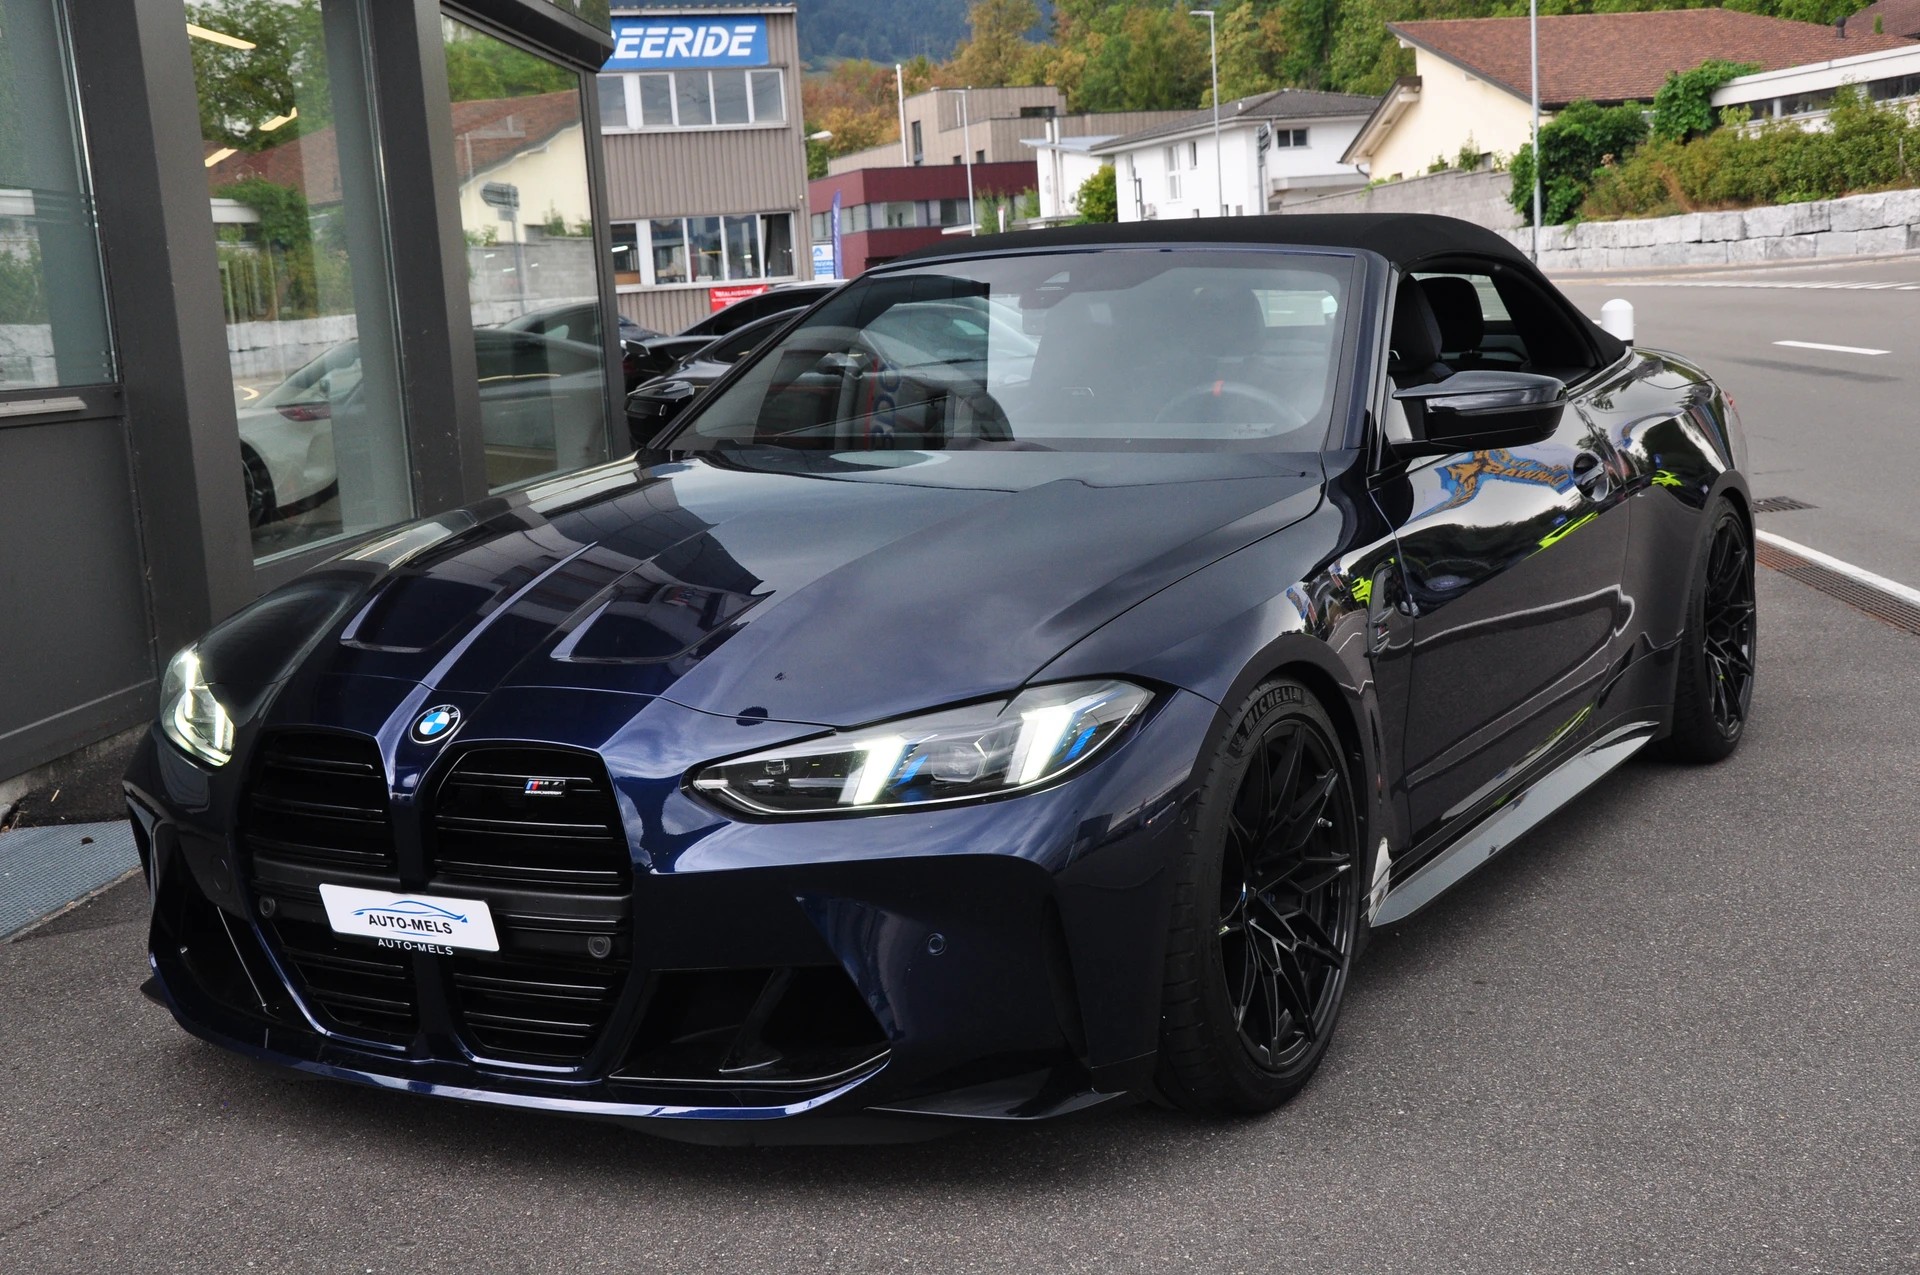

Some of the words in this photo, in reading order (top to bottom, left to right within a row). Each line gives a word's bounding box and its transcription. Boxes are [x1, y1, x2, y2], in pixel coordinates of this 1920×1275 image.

[1243, 686, 1303, 733] MICHELIN
[368, 914, 453, 935] AUTO-MELS
[377, 938, 454, 956] AUTO-MELS
